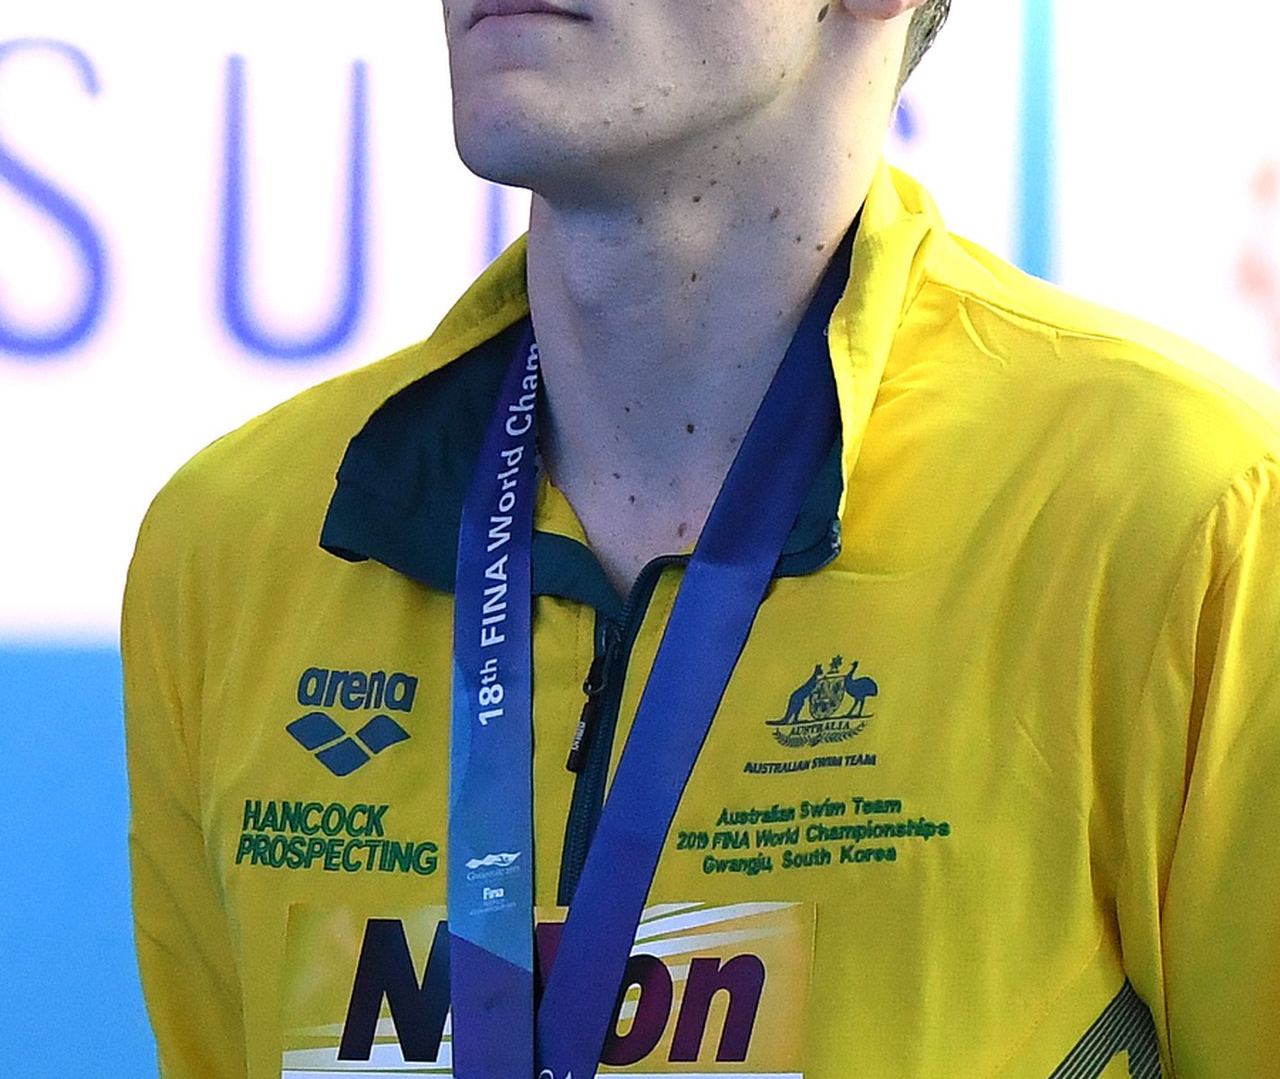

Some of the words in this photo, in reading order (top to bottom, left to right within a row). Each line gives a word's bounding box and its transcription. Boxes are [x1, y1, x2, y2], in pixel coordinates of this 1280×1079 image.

[484, 446, 524, 553] World
[480, 553, 508, 648] FINA
[297, 667, 418, 712] arena
[479, 657, 504, 726] 18th
[844, 753, 876, 767] TEAM
[242, 799, 389, 837] HANCOCK
[716, 804, 795, 826] Australian
[800, 797, 846, 819] Swim
[852, 797, 902, 814] Team
[677, 832, 708, 850] 2019
[712, 831, 750, 850] FINA
[756, 827, 799, 847] World
[806, 817, 950, 842] Championships
[235, 834, 438, 875] PROSPECTING
[782, 848, 831, 868] South
[840, 845, 897, 864] Korea
